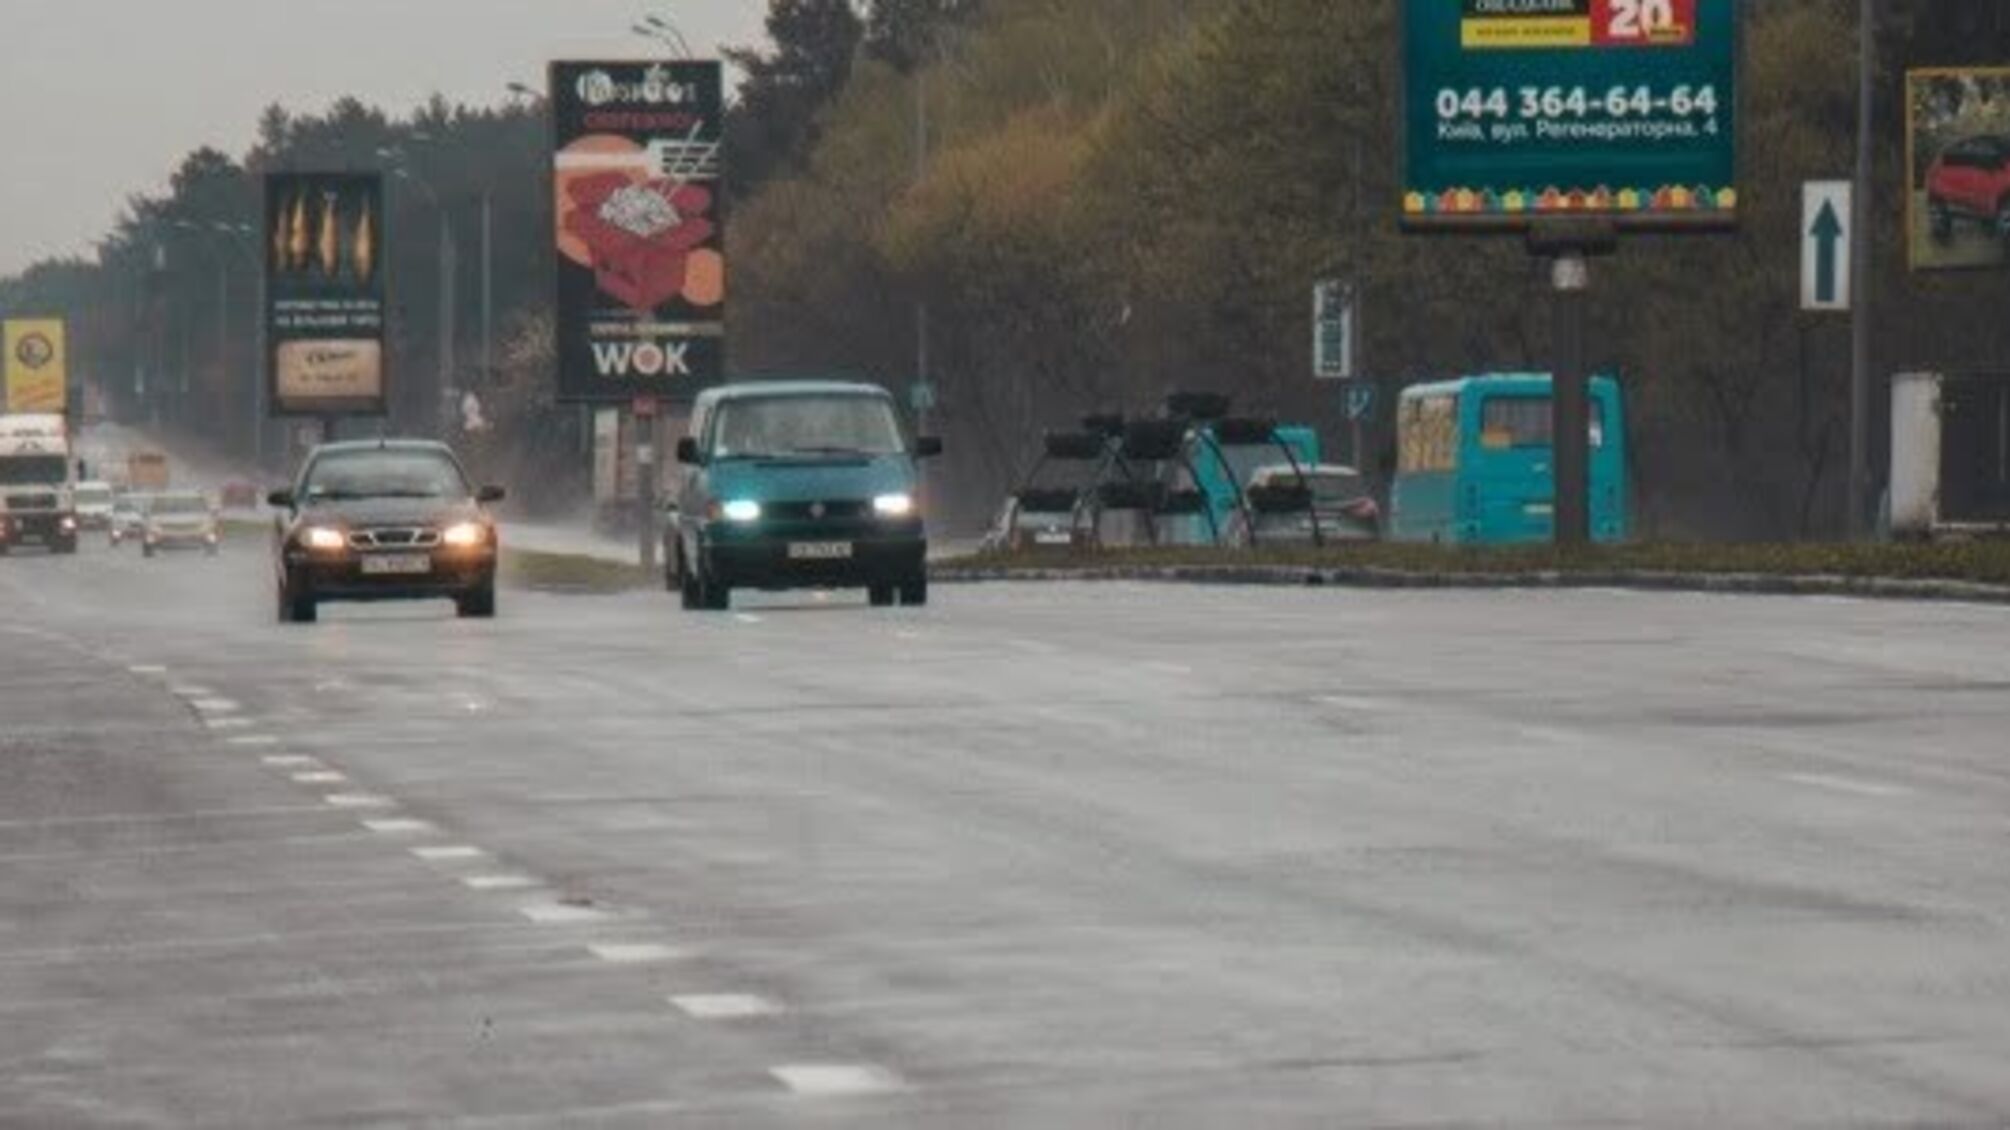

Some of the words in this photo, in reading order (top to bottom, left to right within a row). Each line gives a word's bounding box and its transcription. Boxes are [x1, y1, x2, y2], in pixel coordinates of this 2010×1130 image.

[1608, 0, 1674, 37] 20
[1436, 87, 1507, 119] 044
[1518, 84, 1717, 117] 364-64-64
[1703, 116, 1717, 136] 4
[591, 342, 690, 375] WOK
